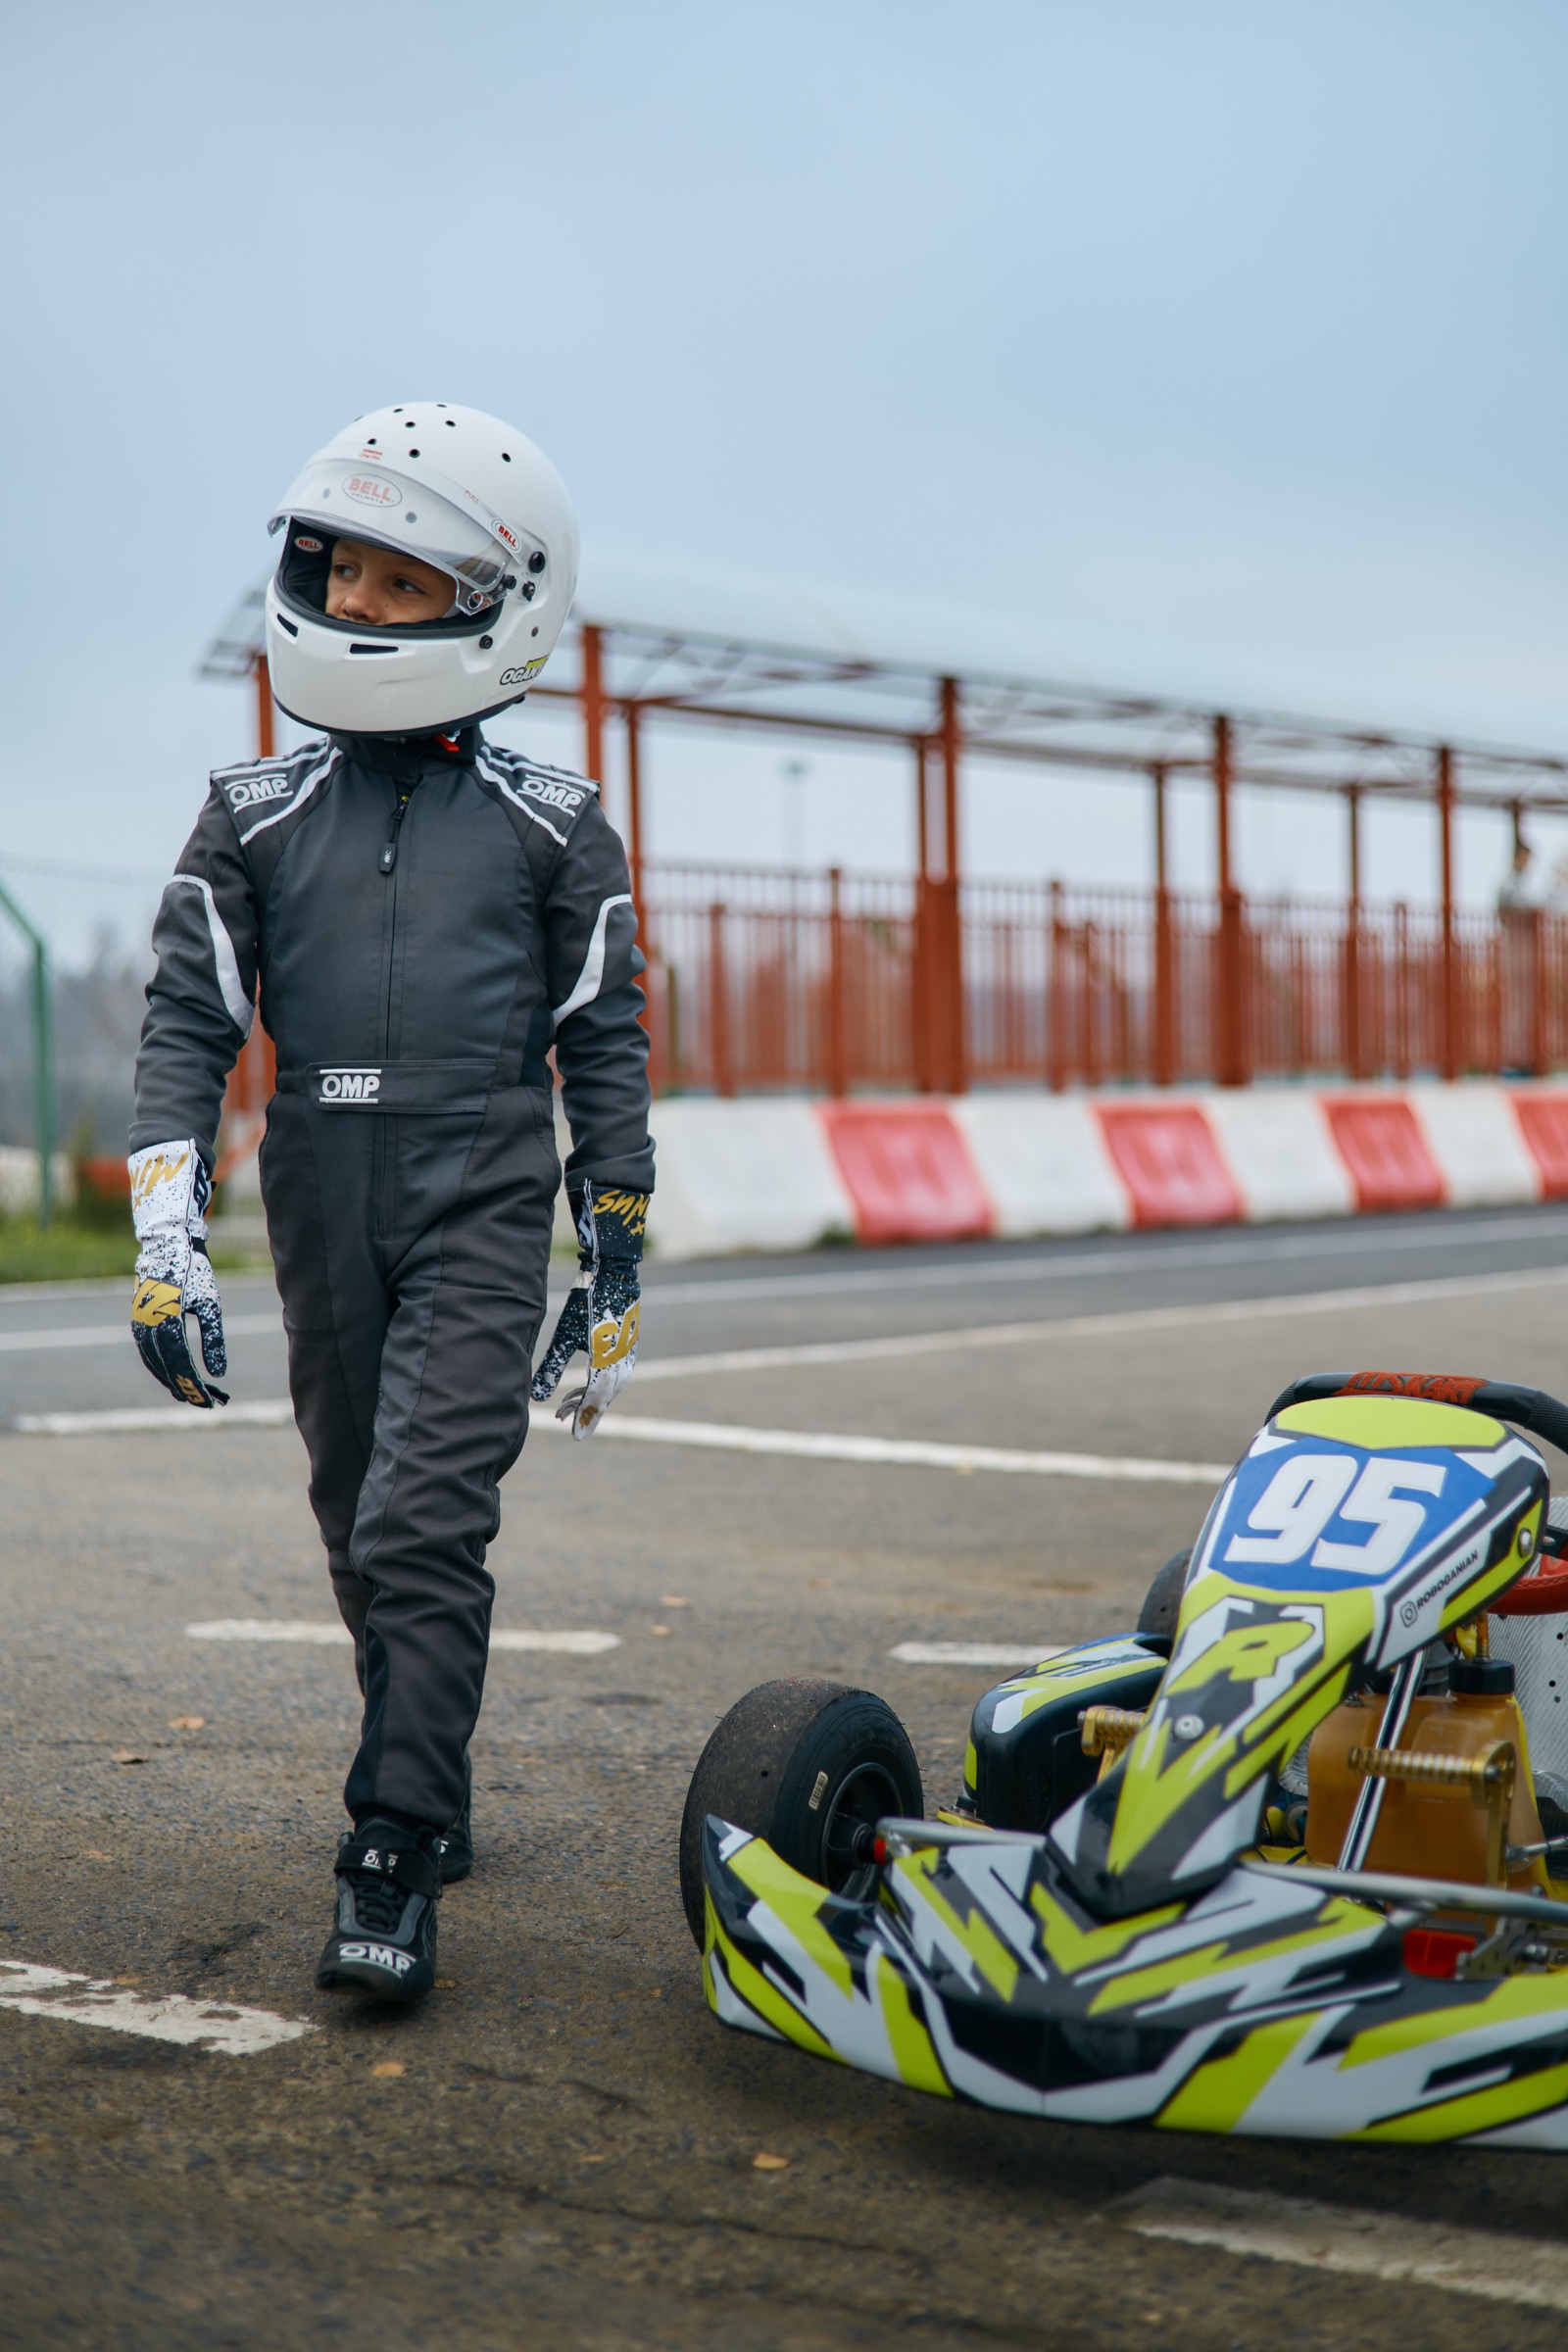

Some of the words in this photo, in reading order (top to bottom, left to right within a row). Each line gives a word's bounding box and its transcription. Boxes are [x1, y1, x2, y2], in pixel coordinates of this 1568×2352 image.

[348, 477, 392, 502] BELL
[298, 538, 319, 549] BELL
[498, 524, 516, 548] BELL
[229, 776, 288, 806] OMP
[521, 779, 582, 808] OMP
[321, 1075, 380, 1099] OMP
[1224, 1454, 1446, 1575] 95
[1416, 1550, 1479, 1610] ROBOGANIAN
[340, 1945, 411, 1973] OMP
